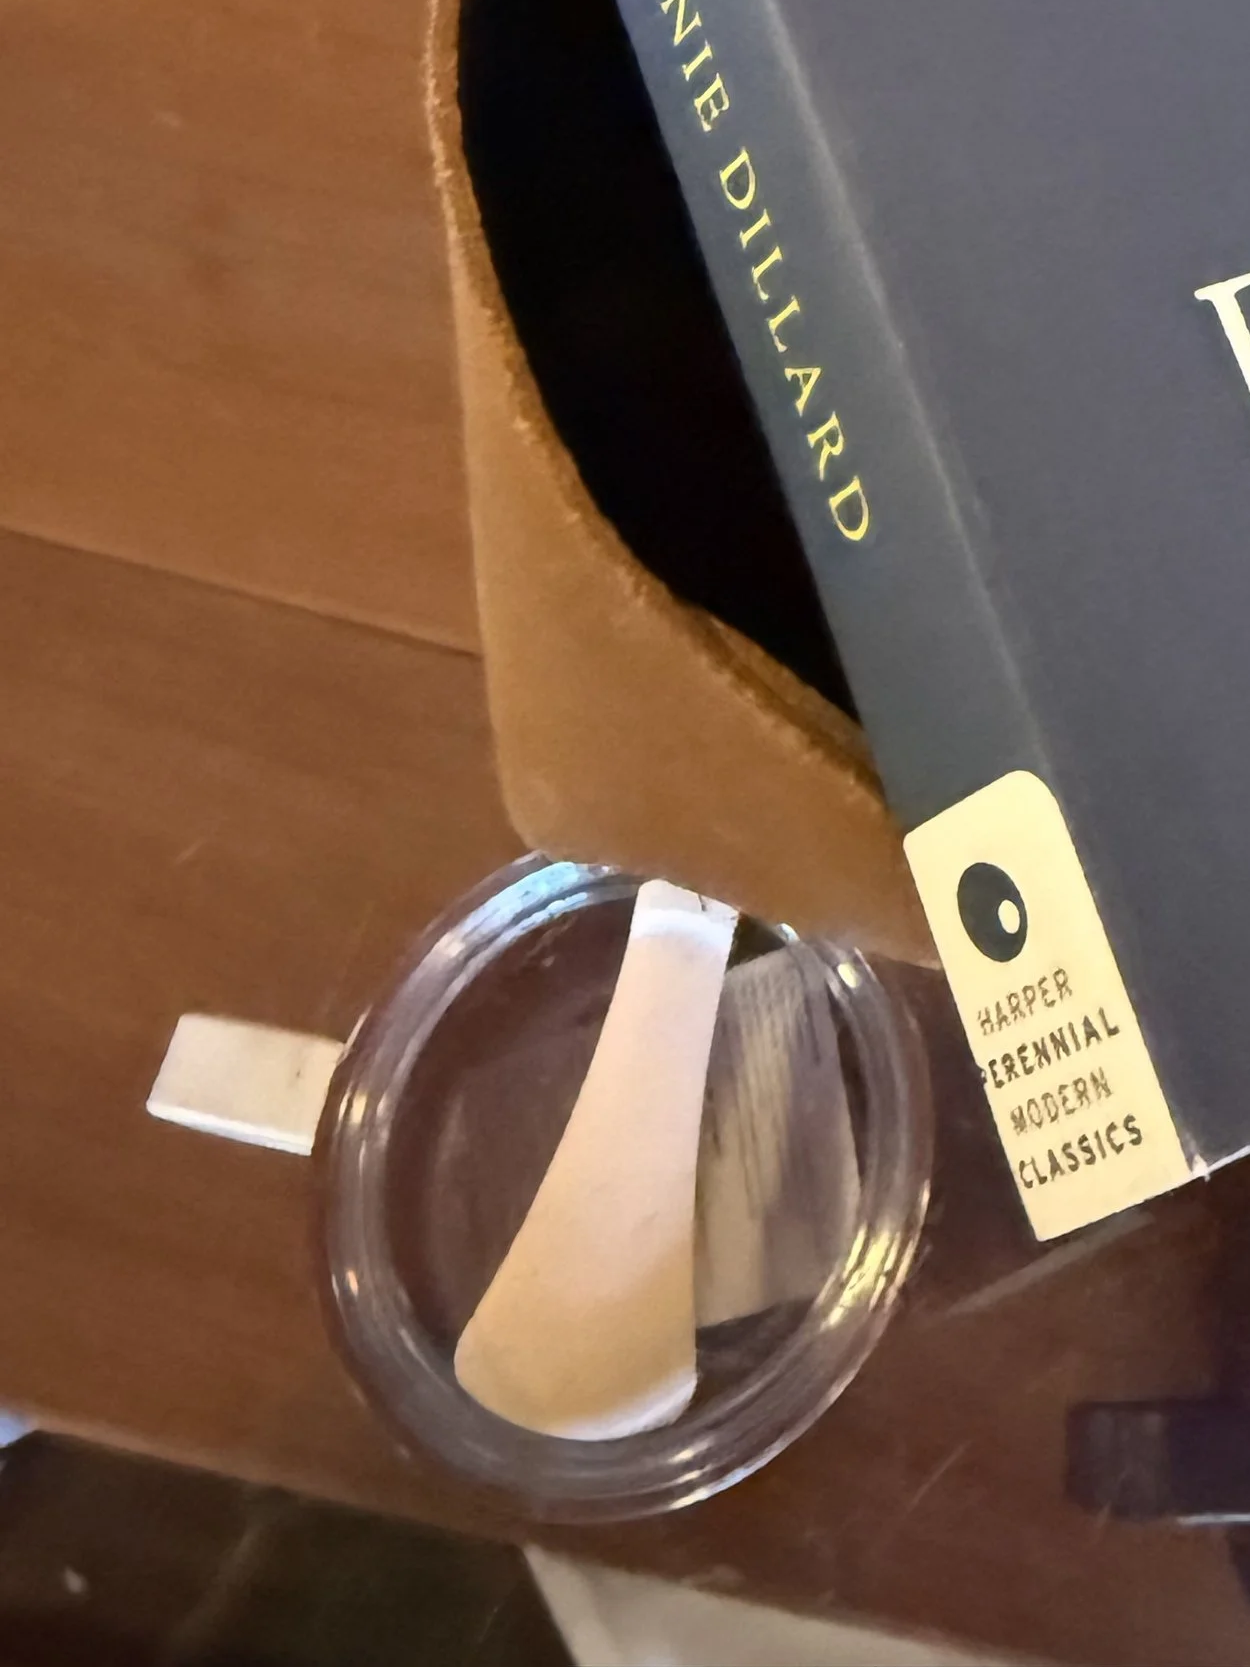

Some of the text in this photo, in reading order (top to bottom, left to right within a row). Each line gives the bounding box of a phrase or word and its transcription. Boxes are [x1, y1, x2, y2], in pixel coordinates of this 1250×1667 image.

[719, 146, 871, 542] DILLARD
[977, 967, 1073, 1036] HARPER
[1010, 1066, 1113, 1135] MODERN
[1018, 1113, 1143, 1190] CLASSICS
